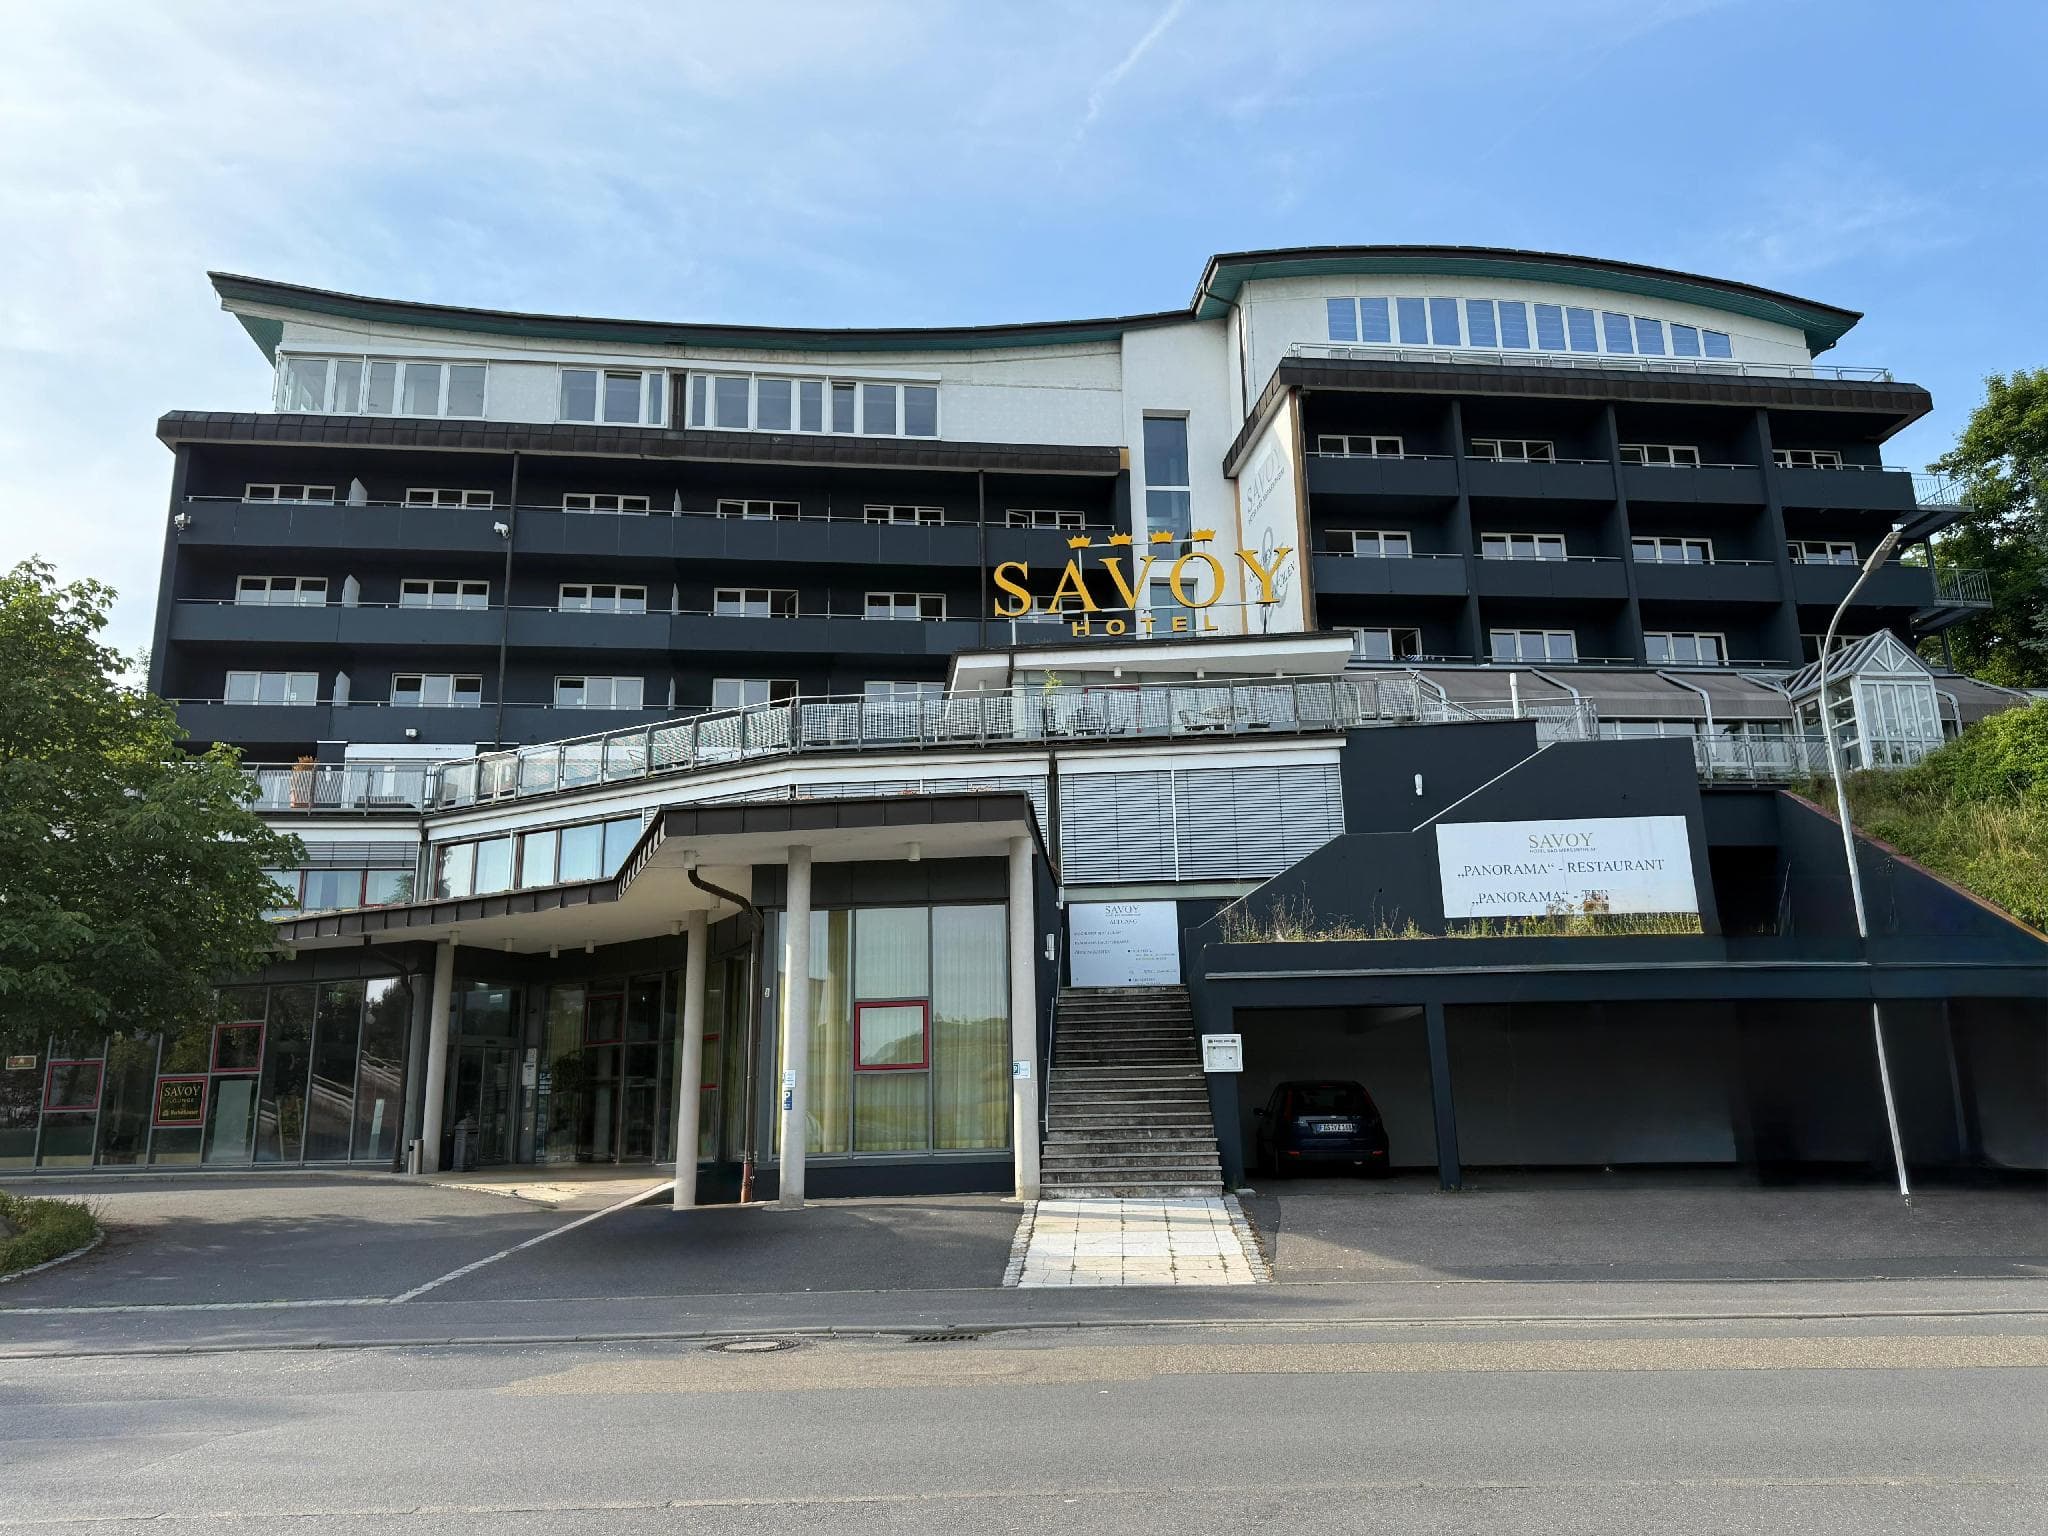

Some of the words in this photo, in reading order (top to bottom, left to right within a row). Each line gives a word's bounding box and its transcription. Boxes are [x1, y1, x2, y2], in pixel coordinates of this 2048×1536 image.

[993, 546, 1294, 618] SAVOY
[1072, 614, 1219, 637] HOTEL
[1528, 832, 1594, 849] SAVOY
[1567, 859, 1665, 873] RESTAURANT
[1105, 904, 1140, 914] SAVOY
[164, 1085, 201, 1097] SAVOY
